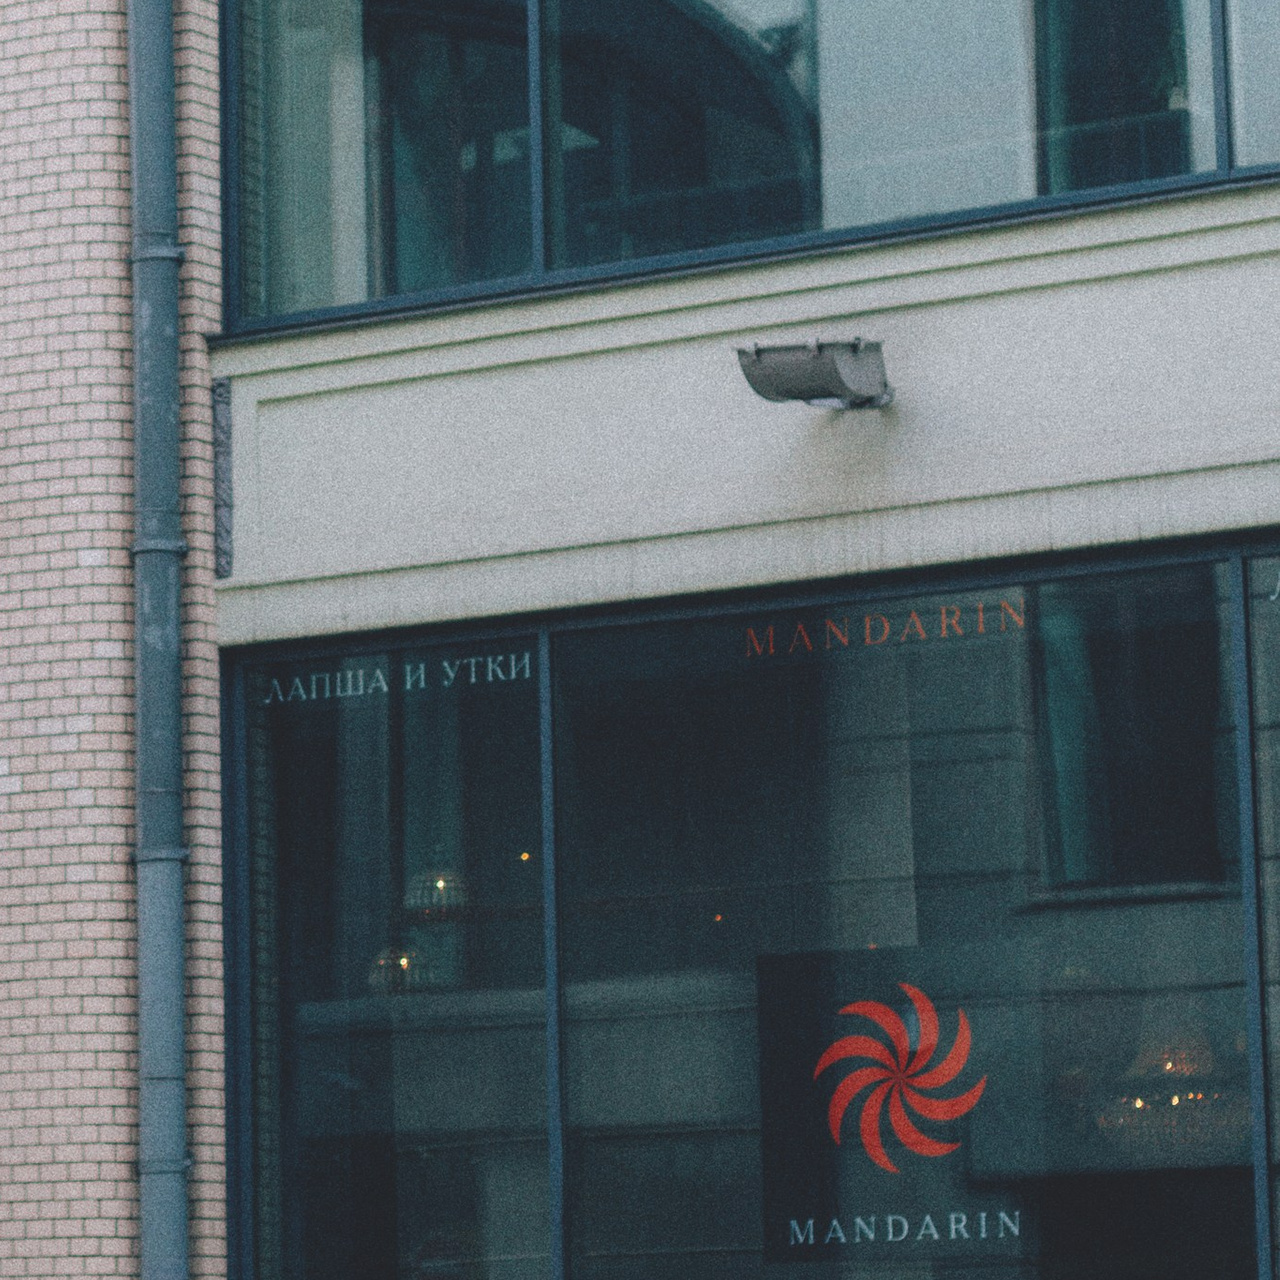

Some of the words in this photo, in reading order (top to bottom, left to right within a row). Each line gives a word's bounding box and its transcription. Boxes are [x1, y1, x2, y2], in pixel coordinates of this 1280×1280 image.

[745, 596, 1025, 658] MANDARIN
[264, 668, 389, 703] ЛАПША
[404, 662, 426, 690] И
[441, 651, 531, 688] УТКИ
[789, 1210, 1020, 1246] MANDARIN
